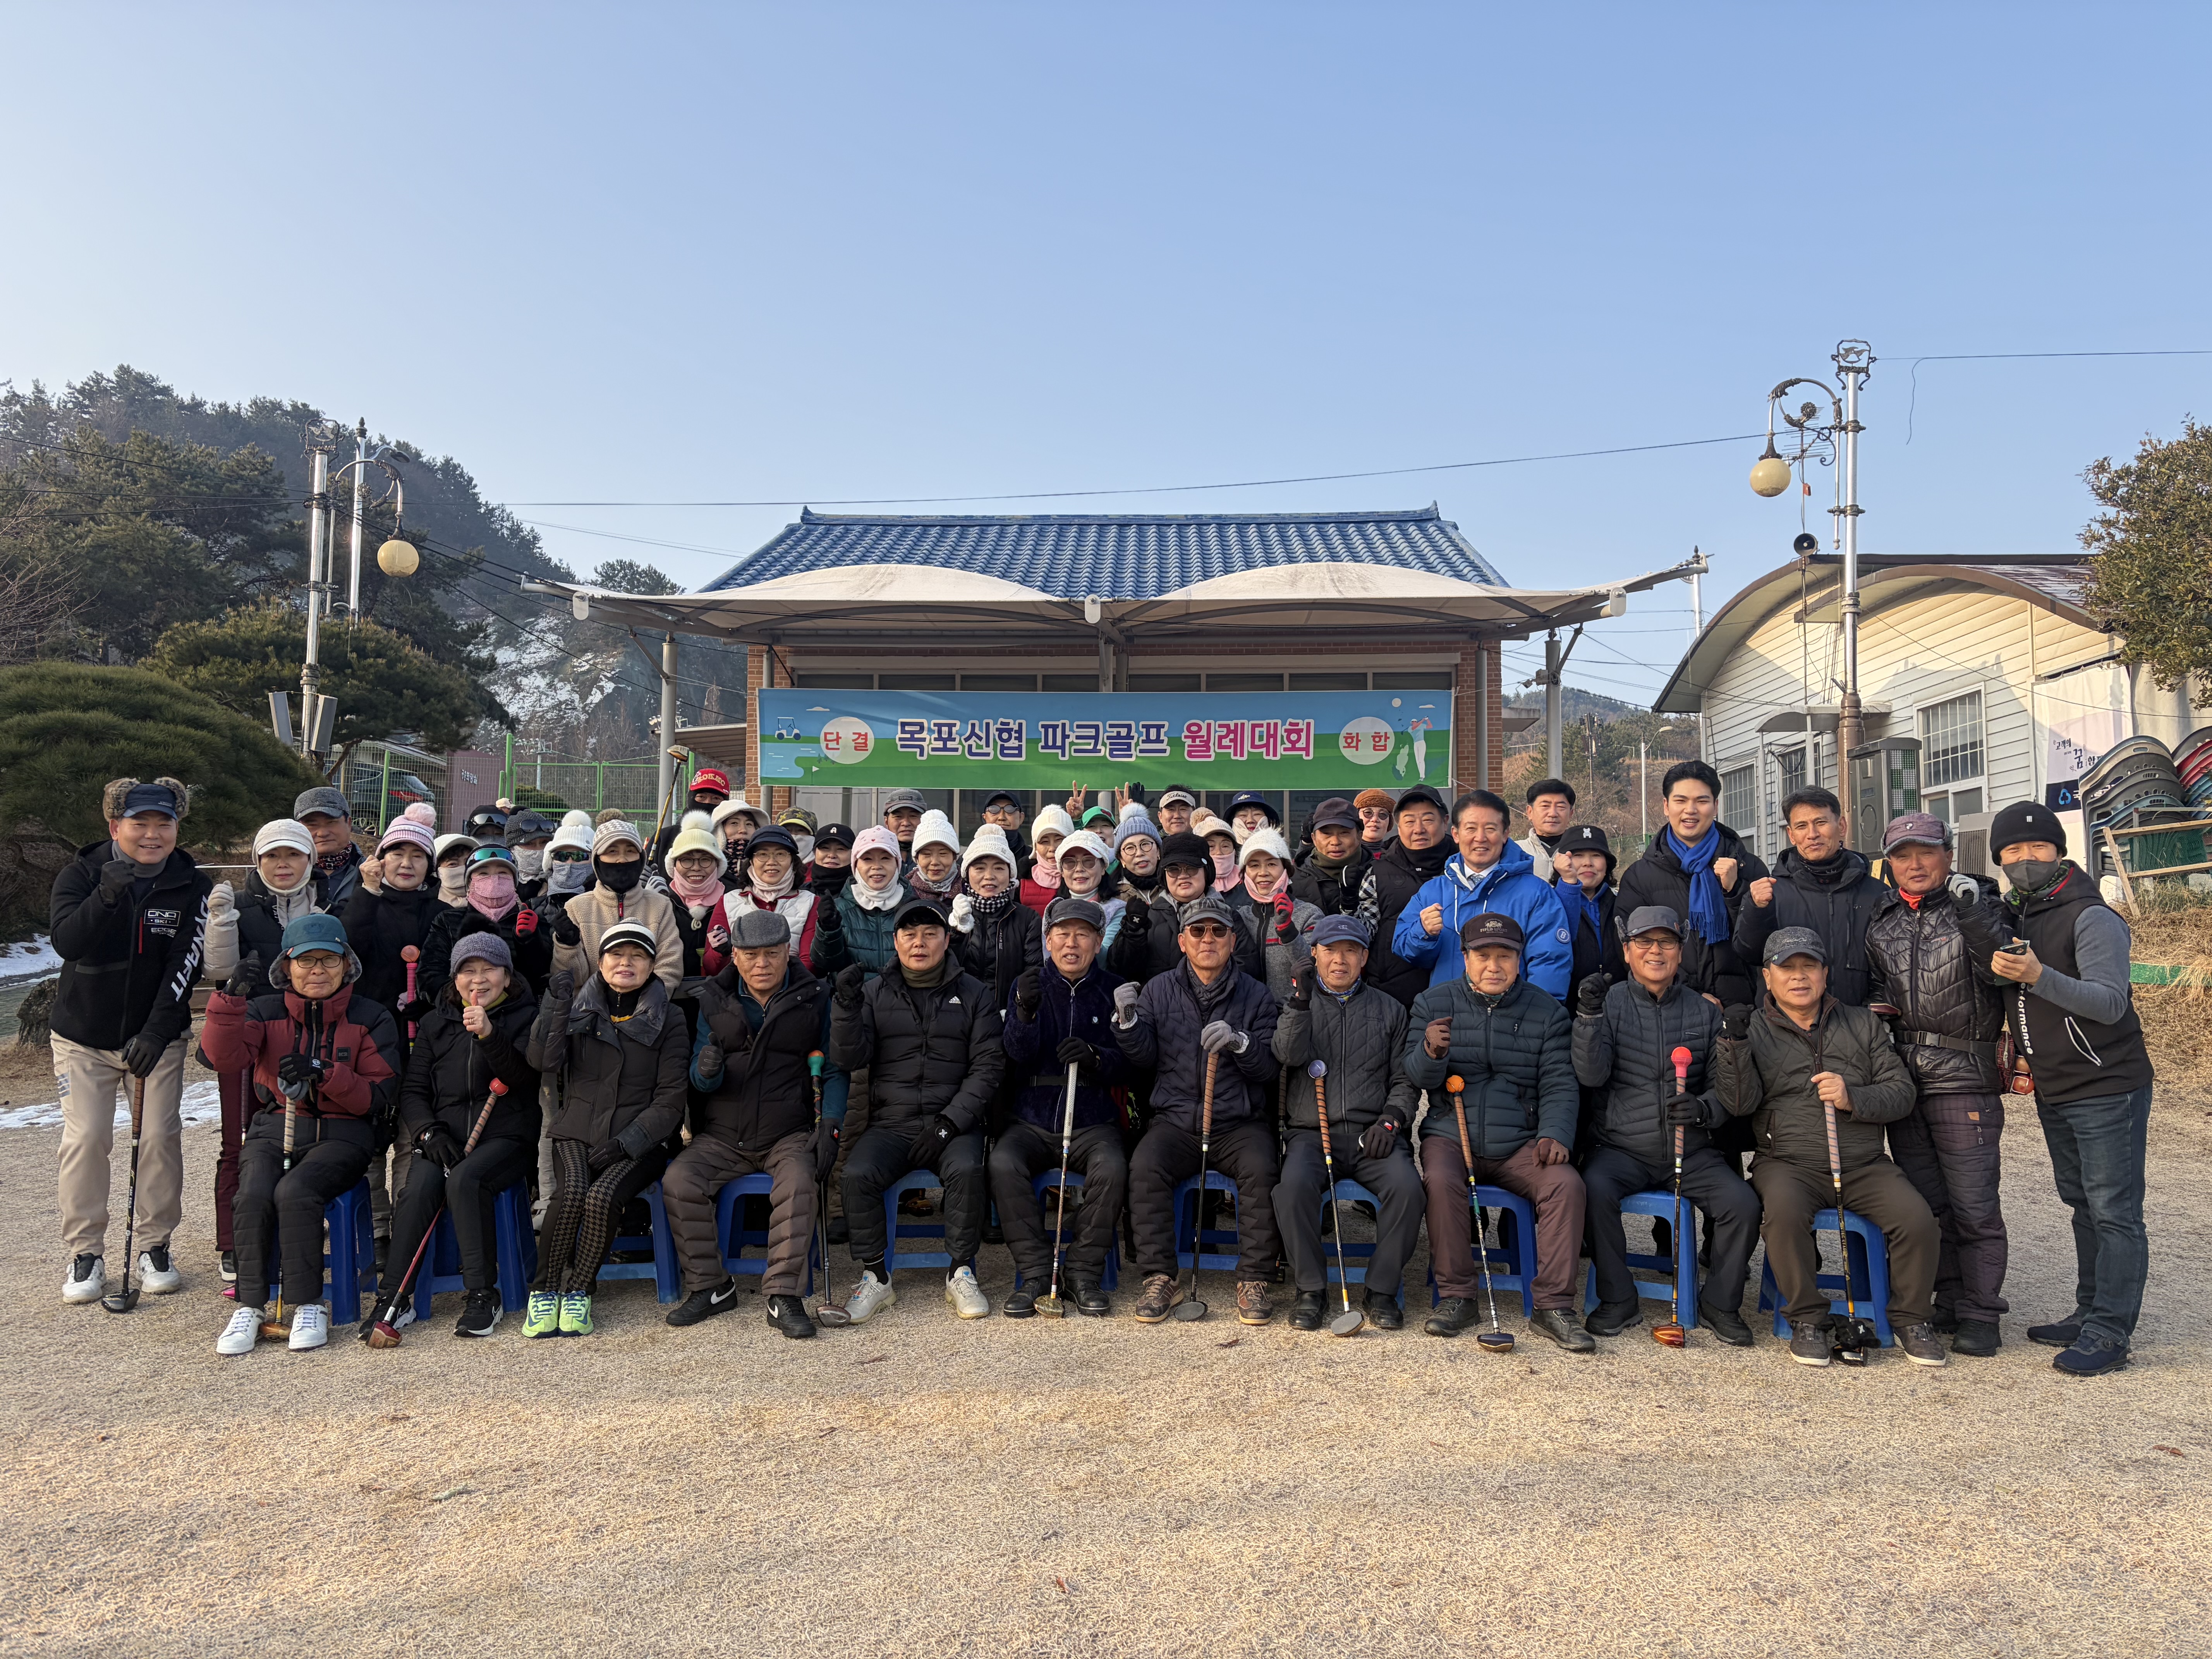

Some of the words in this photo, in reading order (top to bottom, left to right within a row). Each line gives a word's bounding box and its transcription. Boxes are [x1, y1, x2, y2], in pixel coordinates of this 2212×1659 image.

[897, 720, 1024, 759] 목포신협
[1040, 722, 1168, 759] 파크골프
[1183, 720, 1312, 759] 월례대회
[2055, 738, 2071, 750] 고객의
[2073, 748, 2083, 770] 꿈
[2018, 982, 2033, 1054] erformance
